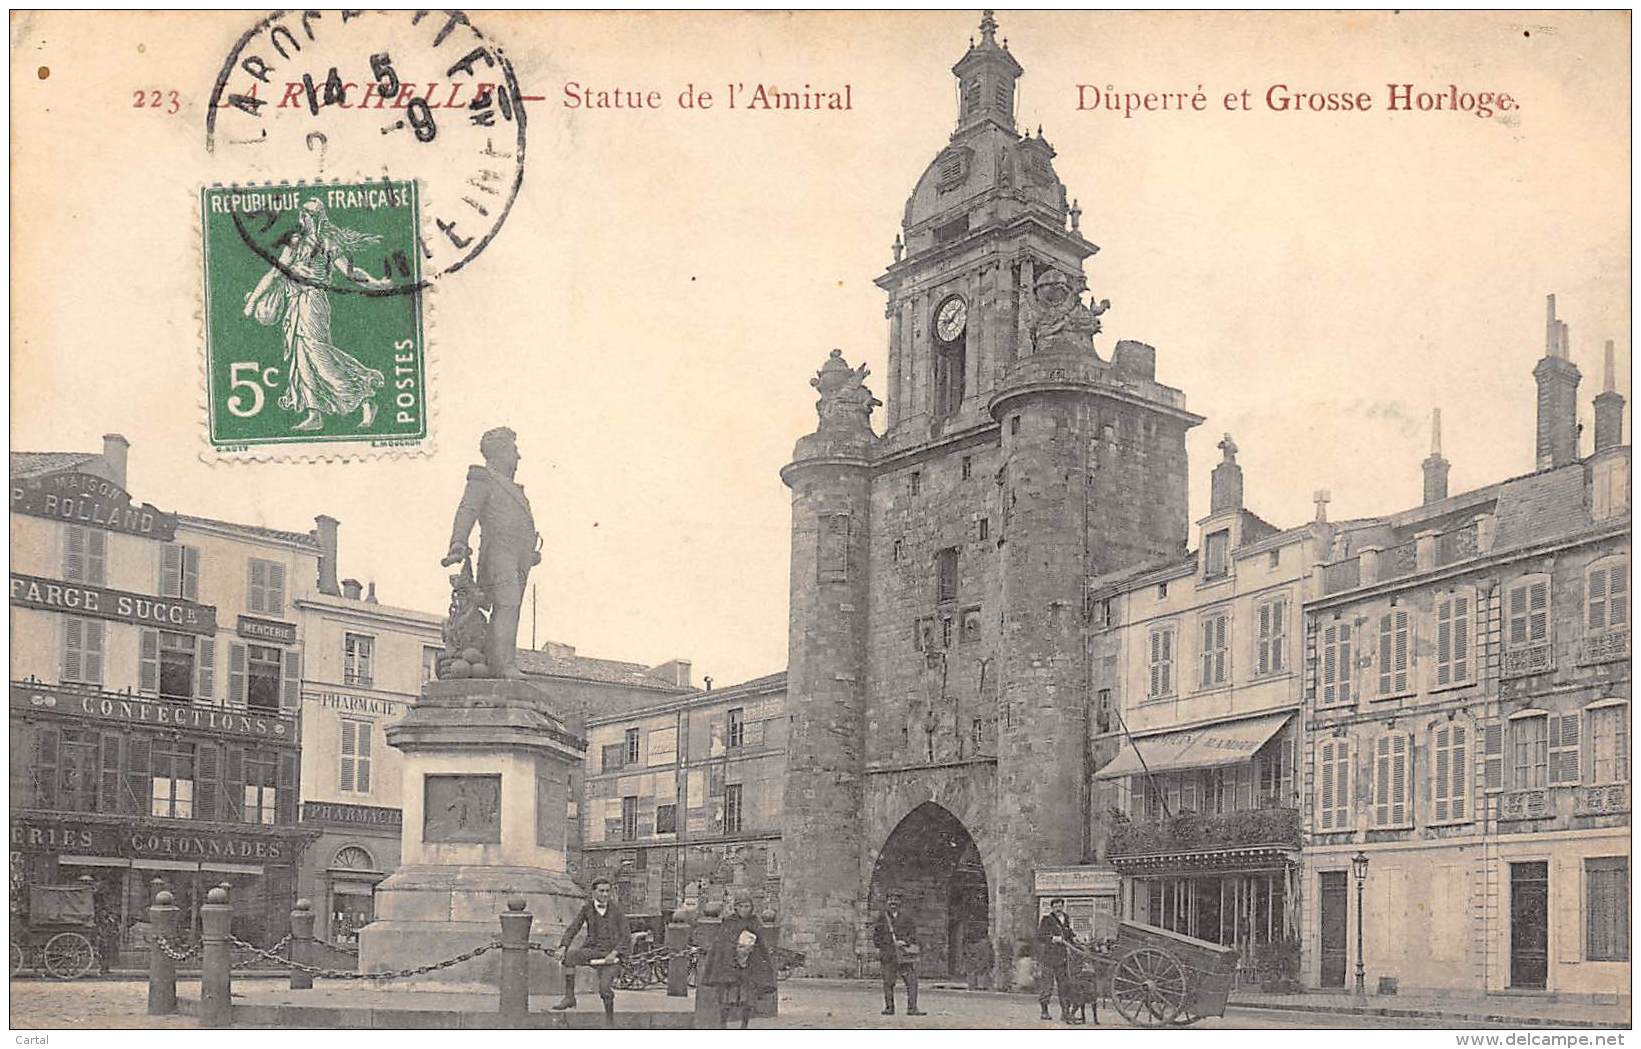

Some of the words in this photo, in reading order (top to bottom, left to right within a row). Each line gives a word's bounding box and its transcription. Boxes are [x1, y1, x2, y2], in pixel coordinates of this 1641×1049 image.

[394, 338, 416, 424] POSTES
[45, 494, 154, 533] ROLLAND
[82, 697, 268, 734] CONFECTIONS
[321, 692, 398, 717] PHARMACIE
[131, 834, 281, 858] COTONNADES
